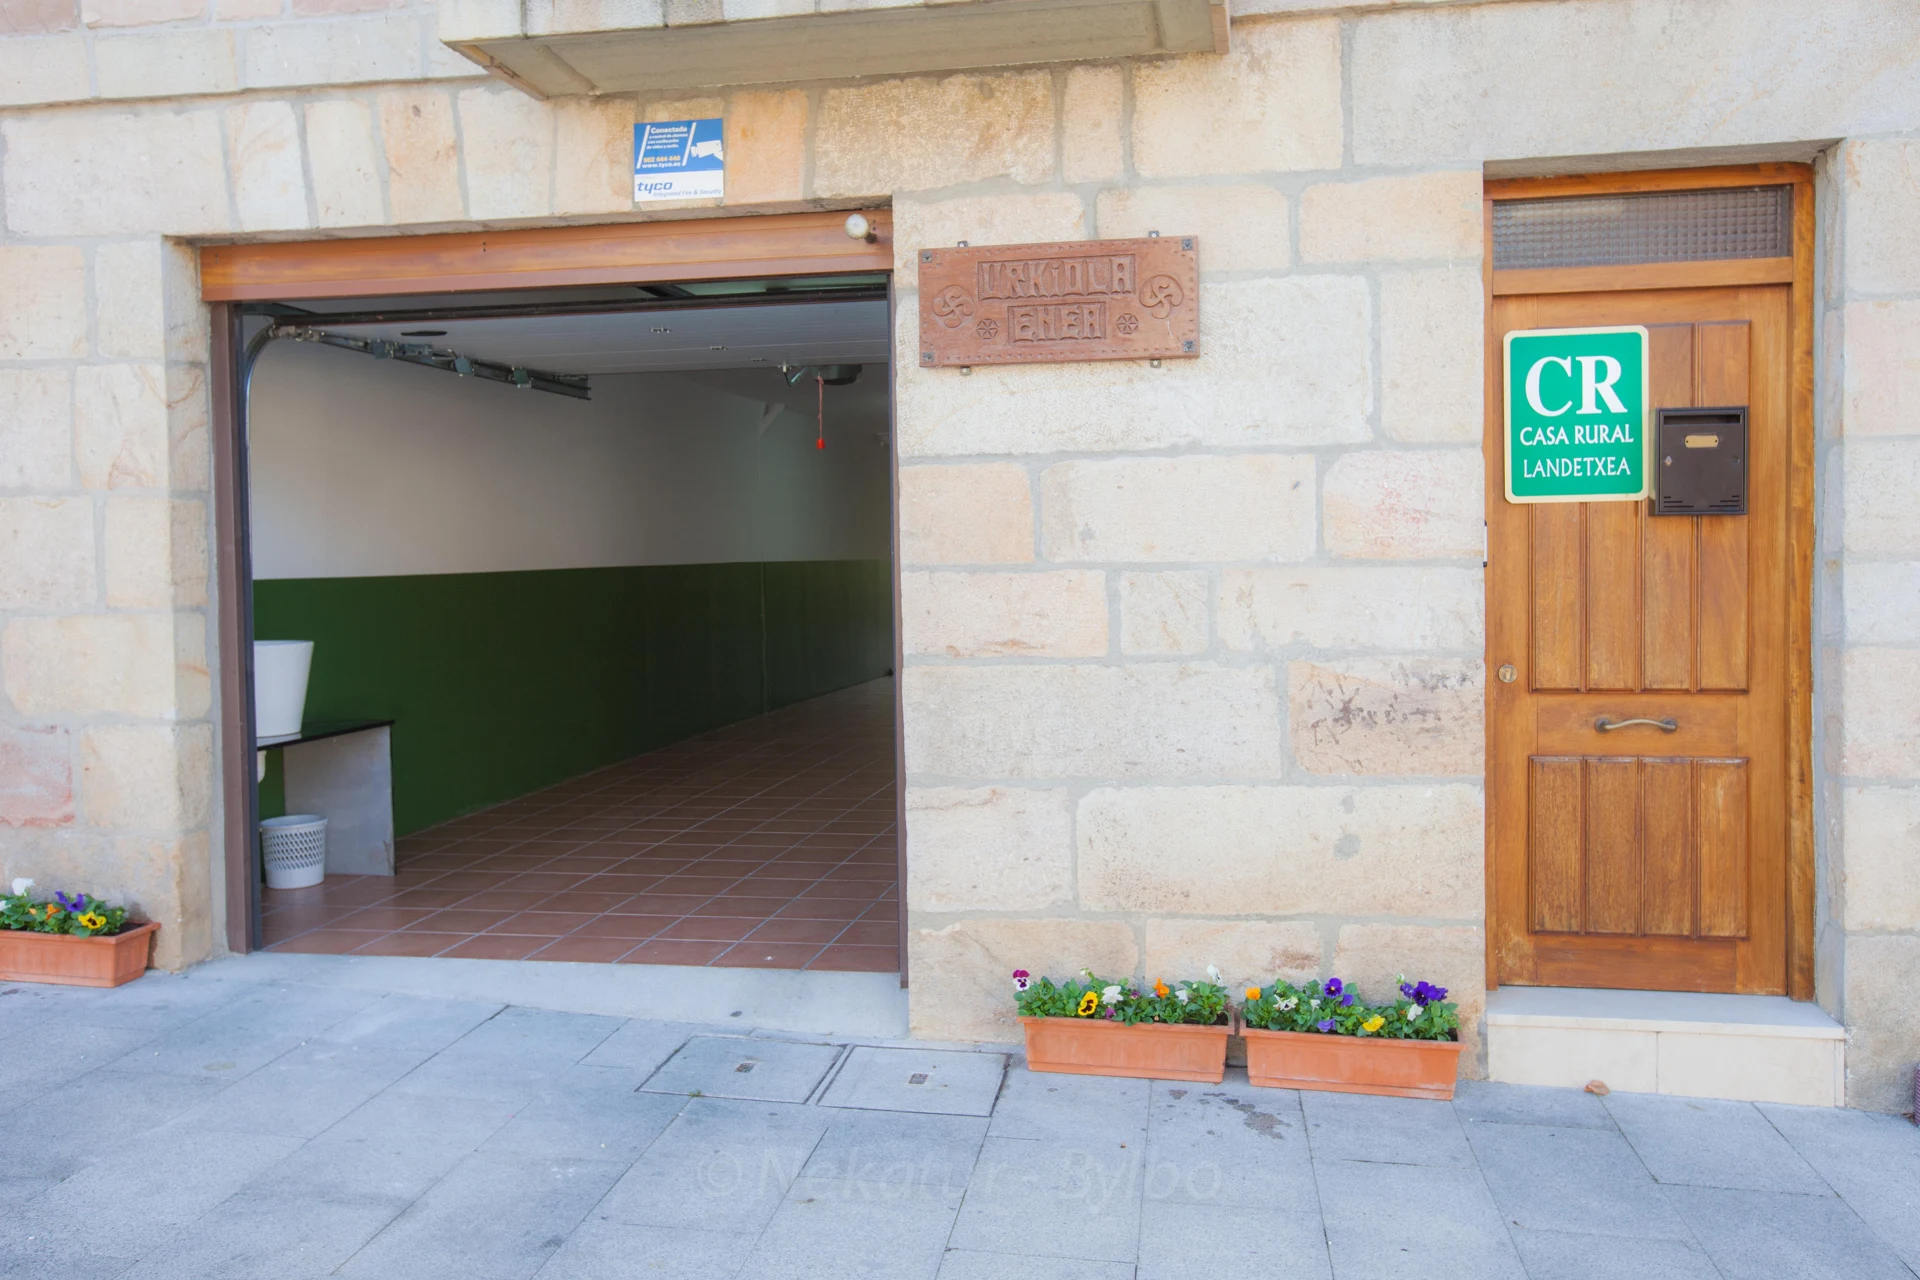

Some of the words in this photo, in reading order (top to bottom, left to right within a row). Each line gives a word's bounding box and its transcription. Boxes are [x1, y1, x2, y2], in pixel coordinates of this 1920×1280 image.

[651, 126, 688, 134] Conectada
[637, 182, 673, 194] tyco
[1013, 304, 1104, 342] ENEA
[1525, 355, 1628, 417] CR
[1520, 426, 1570, 446] CASA
[1574, 424, 1634, 445] RURAL
[1523, 456, 1631, 478] LANDETXEA
